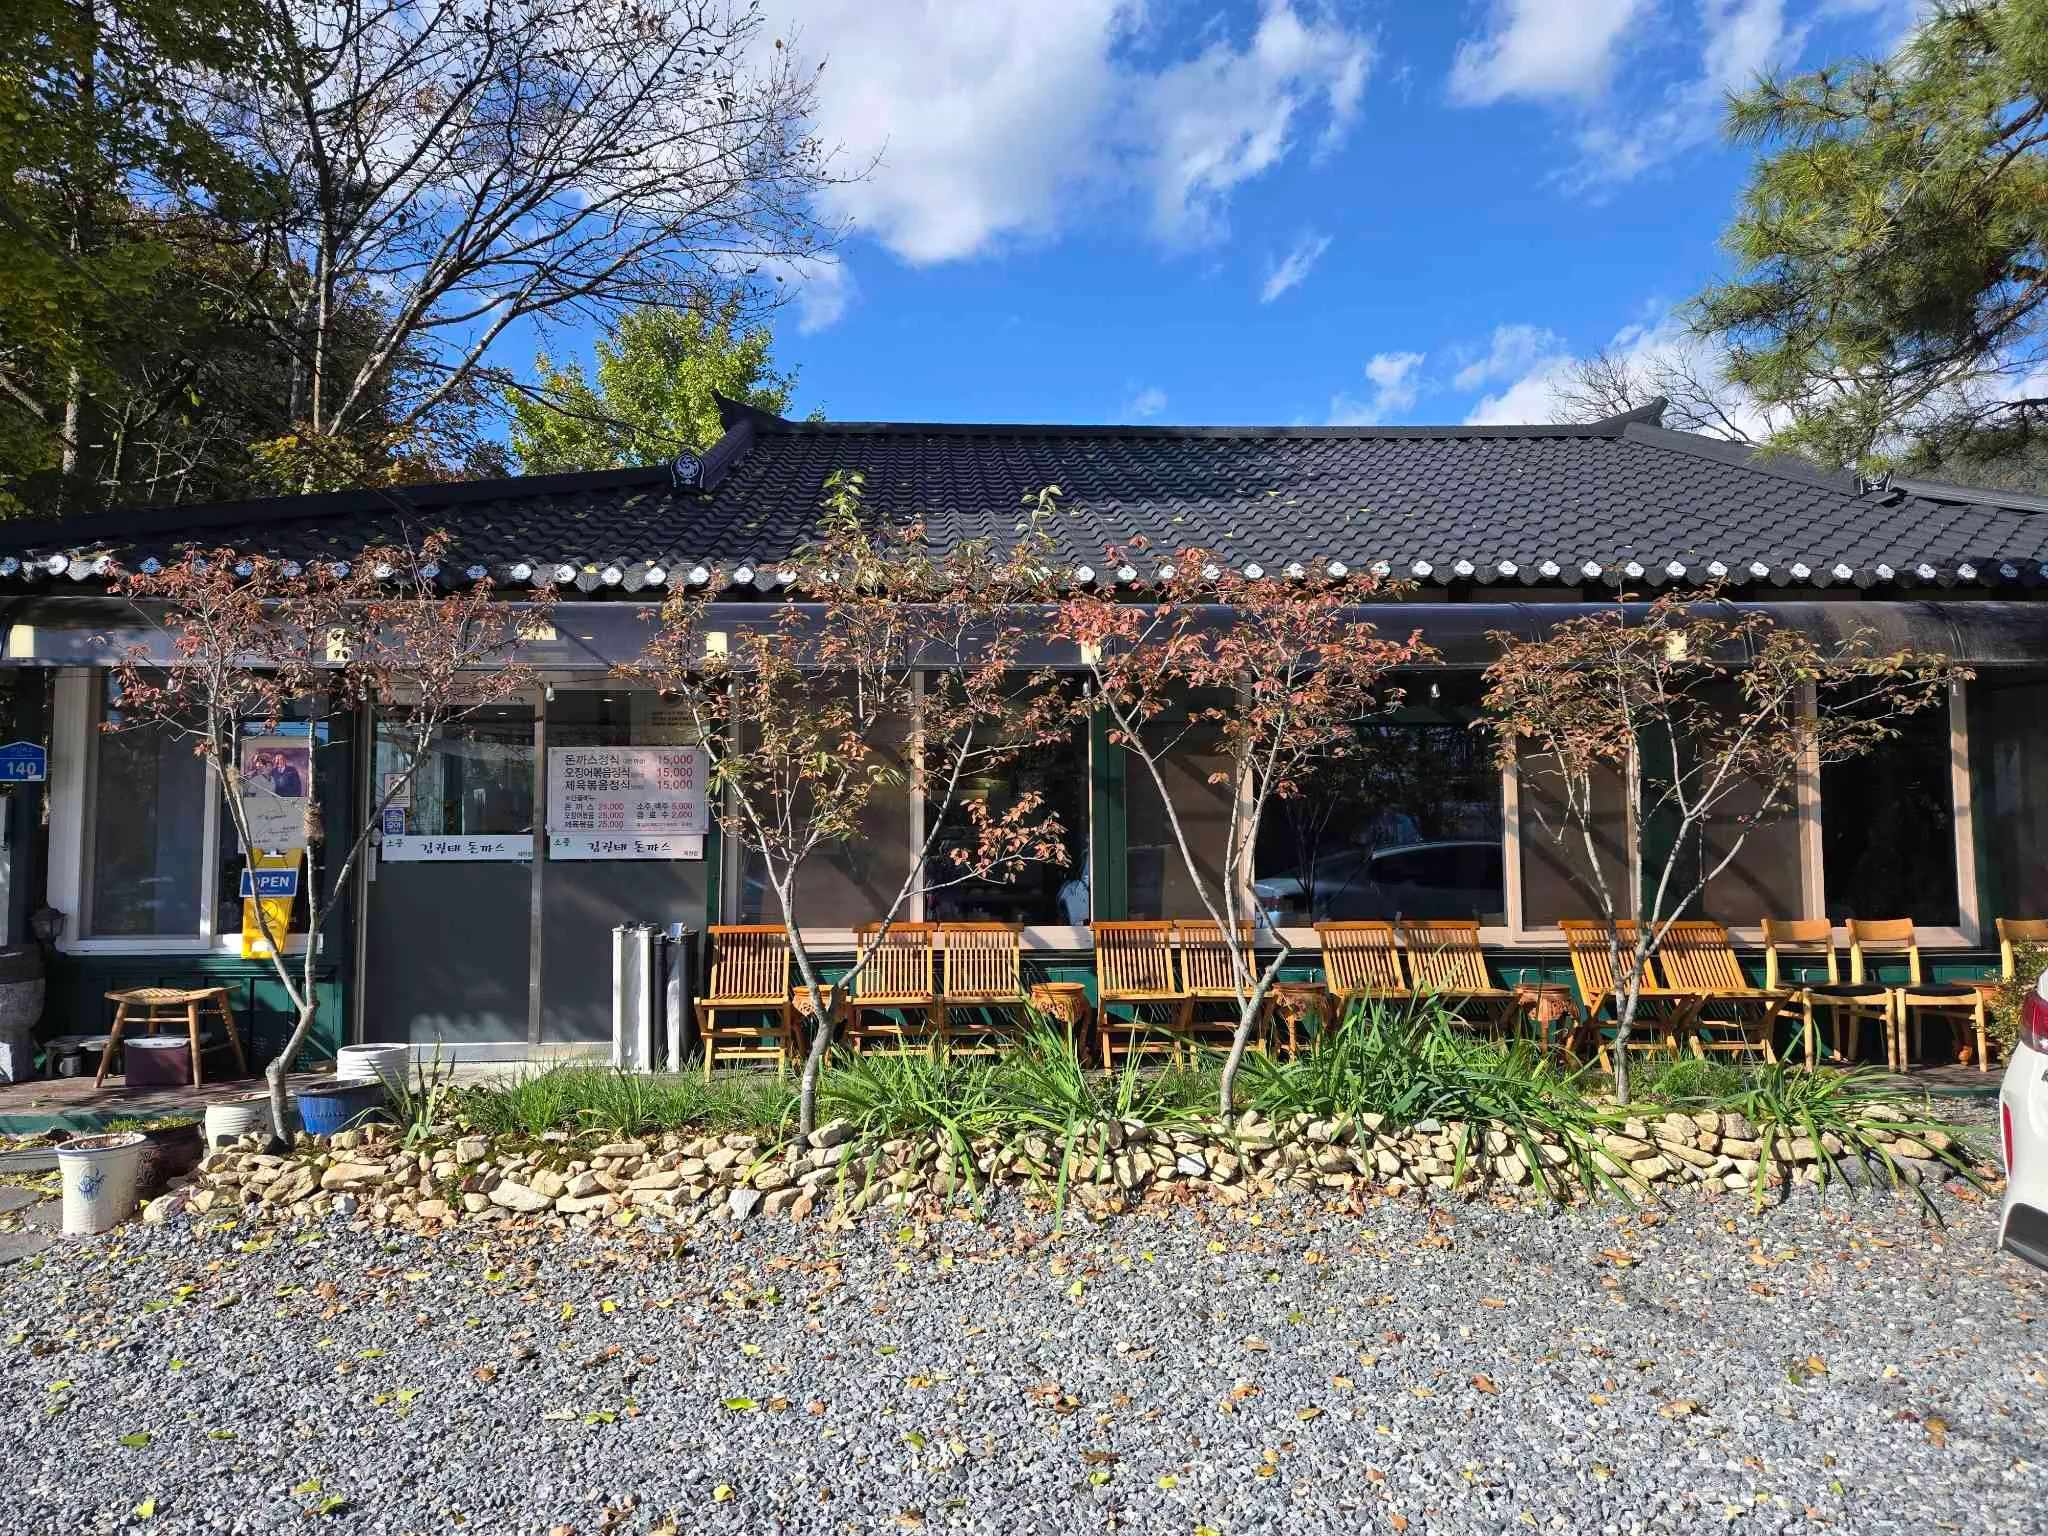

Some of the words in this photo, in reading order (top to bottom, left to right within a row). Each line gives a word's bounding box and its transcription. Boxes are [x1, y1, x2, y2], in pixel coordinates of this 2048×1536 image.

[564, 754, 620, 766] 돈까스정식
[657, 754, 693, 765] 15,000
[7, 761, 37, 776] 140
[564, 767, 630, 779] 오징어볶음정식
[656, 767, 693, 778] 15,000
[564, 780, 630, 791] 제육볶음정식
[656, 780, 693, 791] 15,000
[467, 841, 505, 854] 돈까스
[634, 840, 673, 853] 돈까스
